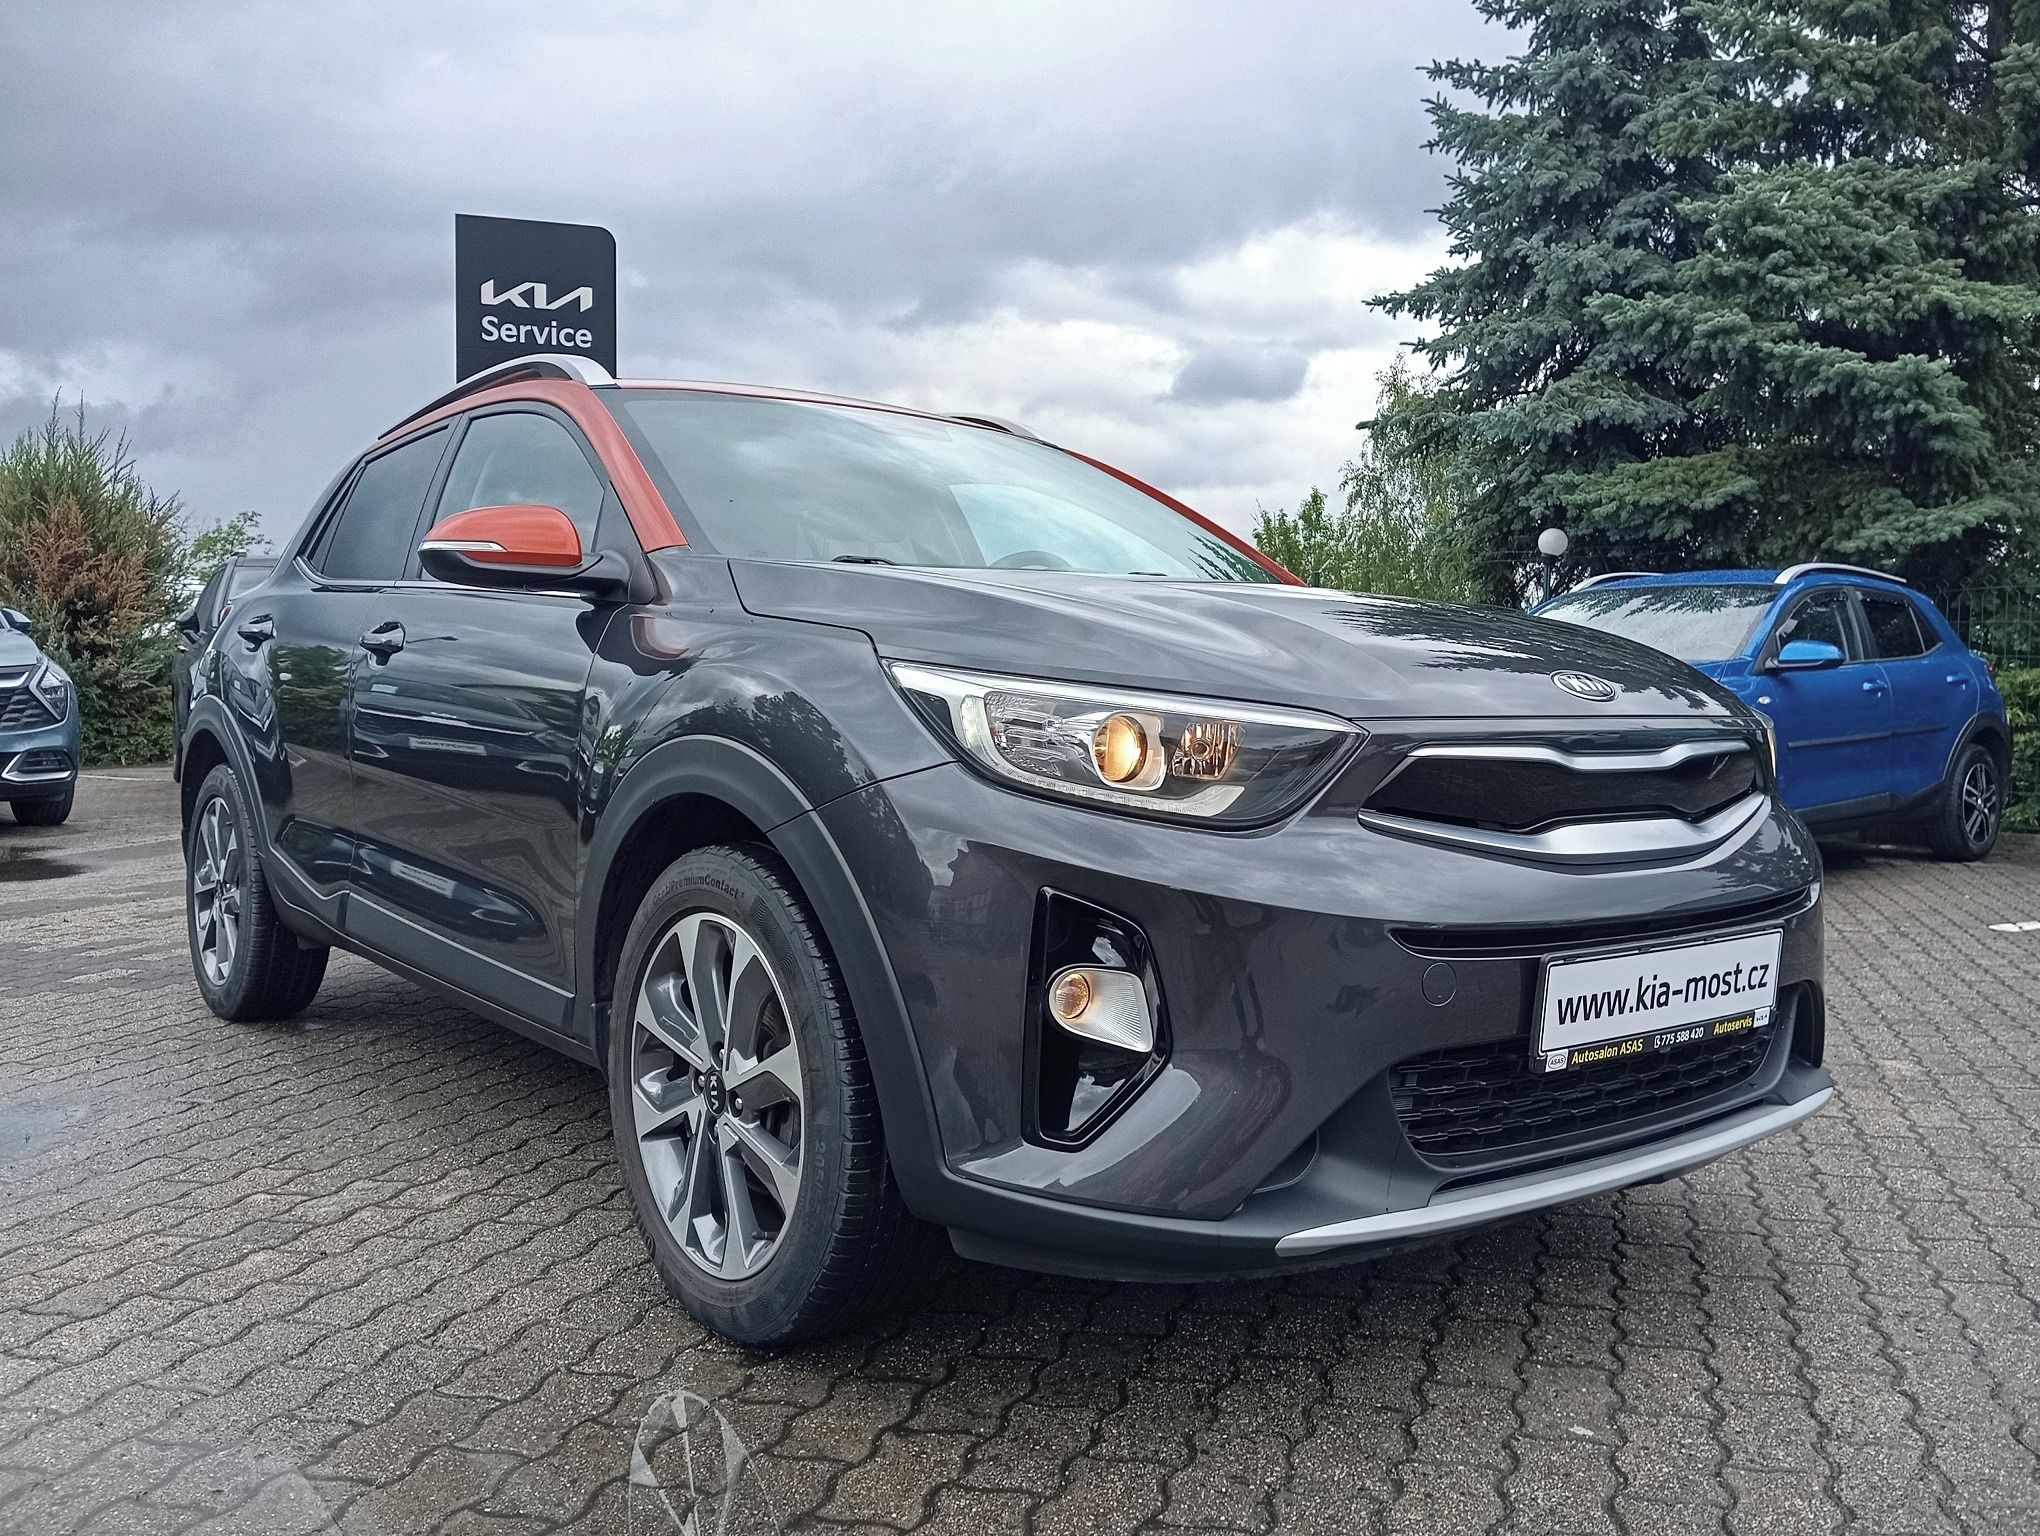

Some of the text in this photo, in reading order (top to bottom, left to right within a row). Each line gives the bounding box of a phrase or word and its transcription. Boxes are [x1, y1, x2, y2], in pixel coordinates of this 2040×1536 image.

[480, 279, 593, 313] KIA
[481, 315, 593, 348] Service
[1556, 962, 1770, 1026] www.kia-most.cz
[1571, 1045, 1618, 1065] Autosalon
[1619, 1038, 1644, 1055] ASAS
[1661, 1033, 1675, 1046] 775
[1675, 1030, 1690, 1043] 588
[1690, 1027, 1704, 1040] 420
[1713, 1015, 1753, 1036] Autoservis
